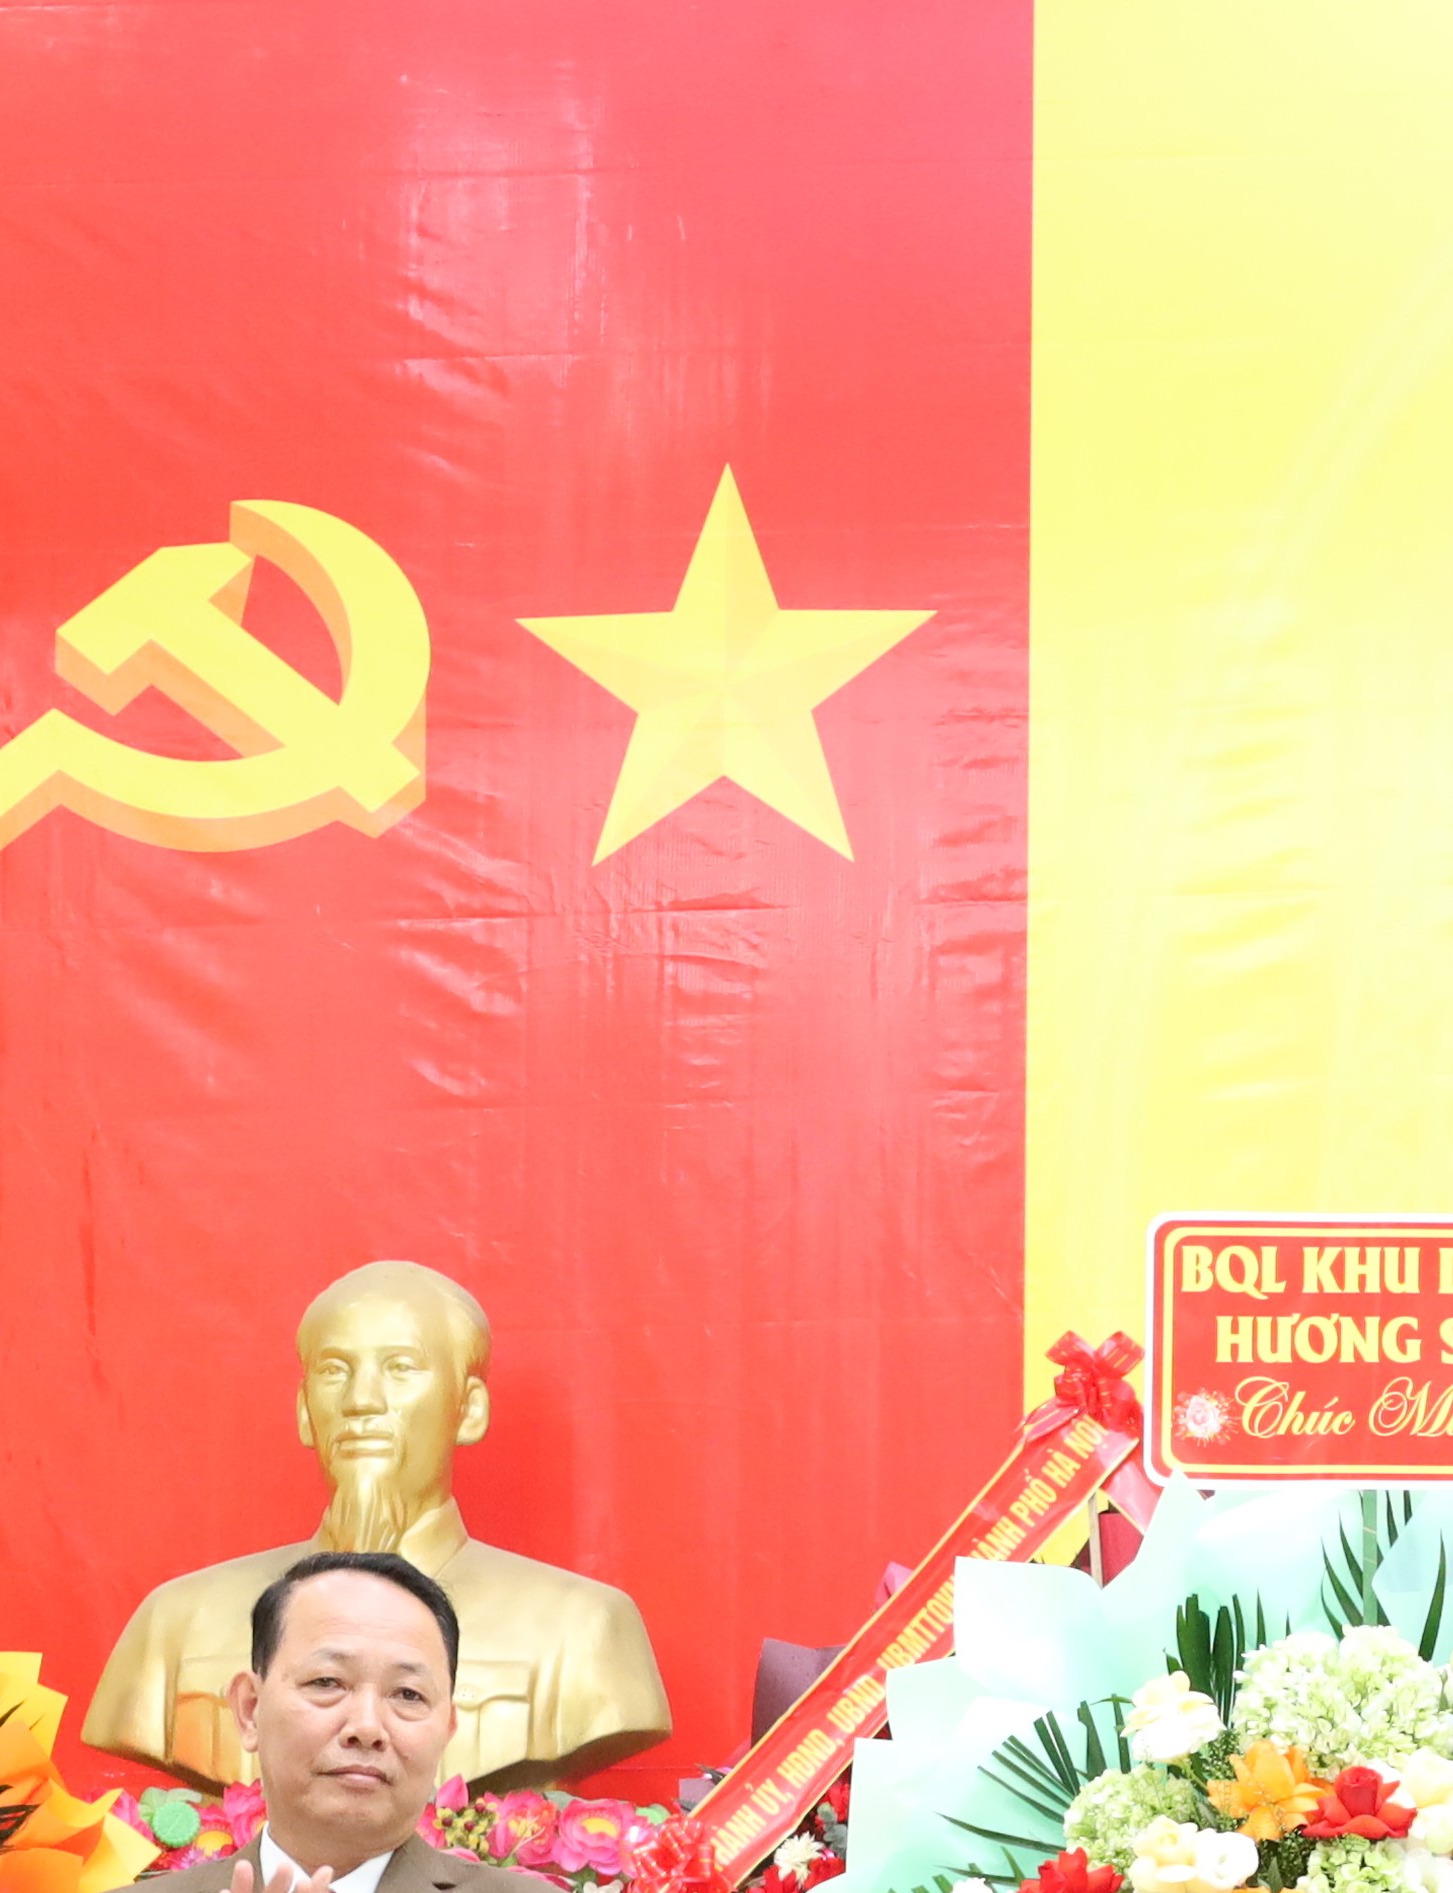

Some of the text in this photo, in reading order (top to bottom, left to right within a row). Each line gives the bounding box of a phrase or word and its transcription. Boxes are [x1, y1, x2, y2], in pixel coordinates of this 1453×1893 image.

[1181, 1245, 1287, 1299] BQL
[1302, 1247, 1420, 1294] KHU
[1215, 1313, 1422, 1364] HƯƠNG
[1235, 1376, 1356, 1439] Chúc
[1009, 1468, 1058, 1528] PHỐ
[1041, 1448, 1082, 1489] HÀ
[1063, 1414, 1110, 1460] NỘI
